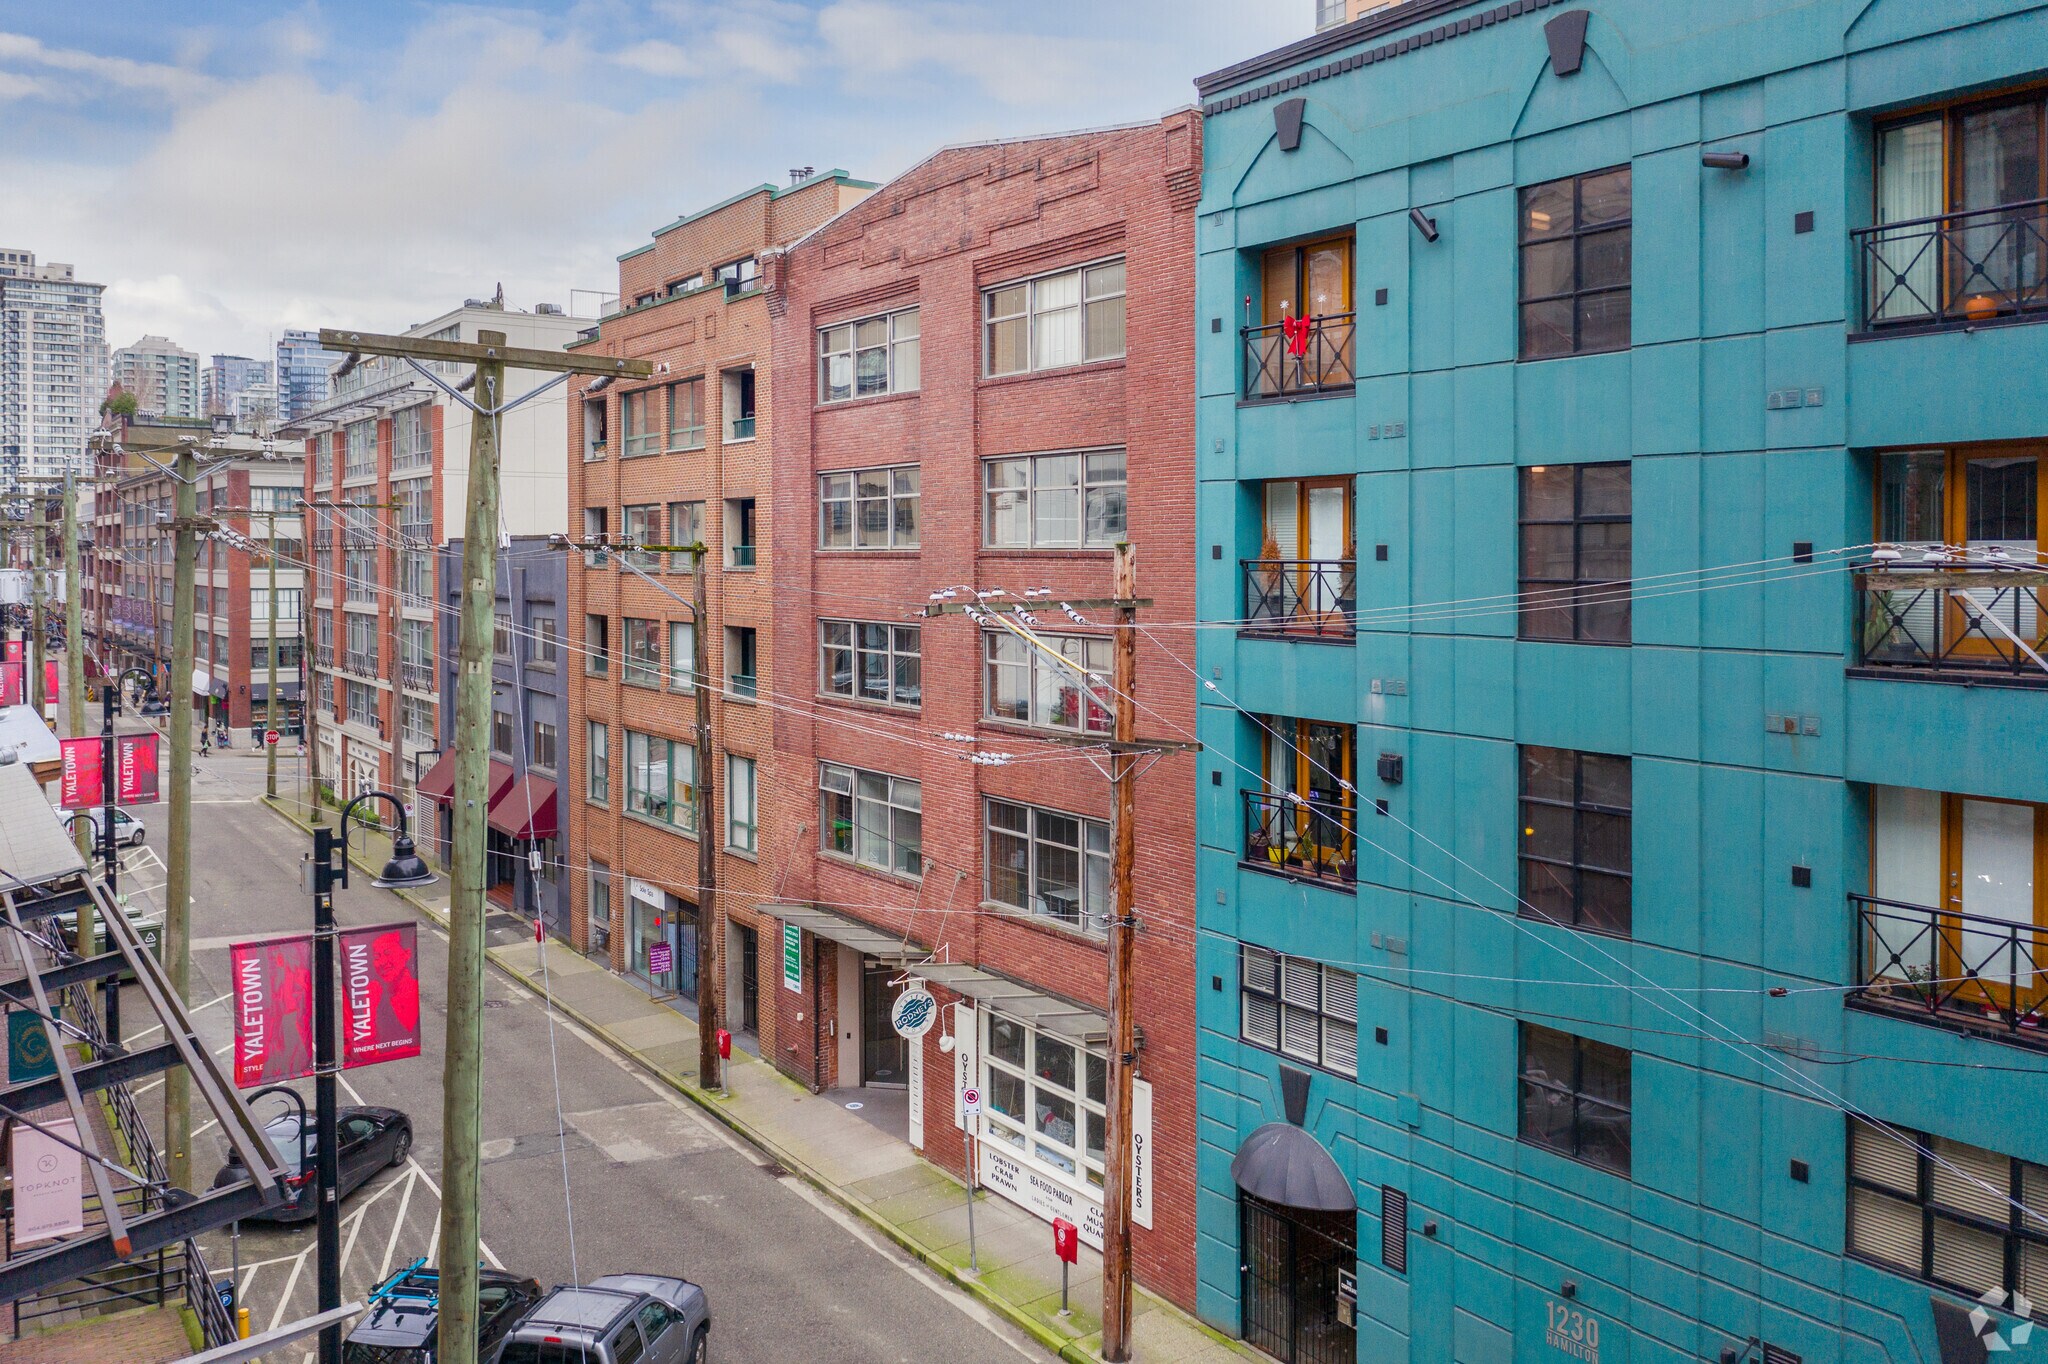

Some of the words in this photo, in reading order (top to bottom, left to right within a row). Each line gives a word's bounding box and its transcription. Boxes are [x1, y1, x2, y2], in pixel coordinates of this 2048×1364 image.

[266, 732, 279, 741] STOP
[65, 746, 77, 798] YALETOWN
[122, 742, 134, 793] YALETOWN
[349, 943, 372, 1042] YALETOWN
[241, 958, 264, 1061] YALETOWN
[353, 1043, 375, 1053] WHERE
[375, 1041, 391, 1050] NEXT
[391, 1038, 413, 1048] BEGINS
[243, 1063, 264, 1073] STYLE
[961, 1053, 969, 1088] OYST
[989, 1152, 1020, 1175] LOBSTER
[994, 1166, 1014, 1181] CRAB
[1134, 1133, 1143, 1209] OYSTERS
[20, 1176, 77, 1193] TOPKNOT
[991, 1172, 1018, 1193] PRAWN
[1030, 1175, 1039, 1188] SEA
[1040, 1180, 1053, 1195] FOOD
[1053, 1187, 1073, 1206] PARLOR
[1086, 1215, 1104, 1229] MUS
[1090, 1207, 1104, 1218] CLA
[1546, 1301, 1599, 1348] 1230
[1546, 1331, 1599, 1364] HAMILTON
